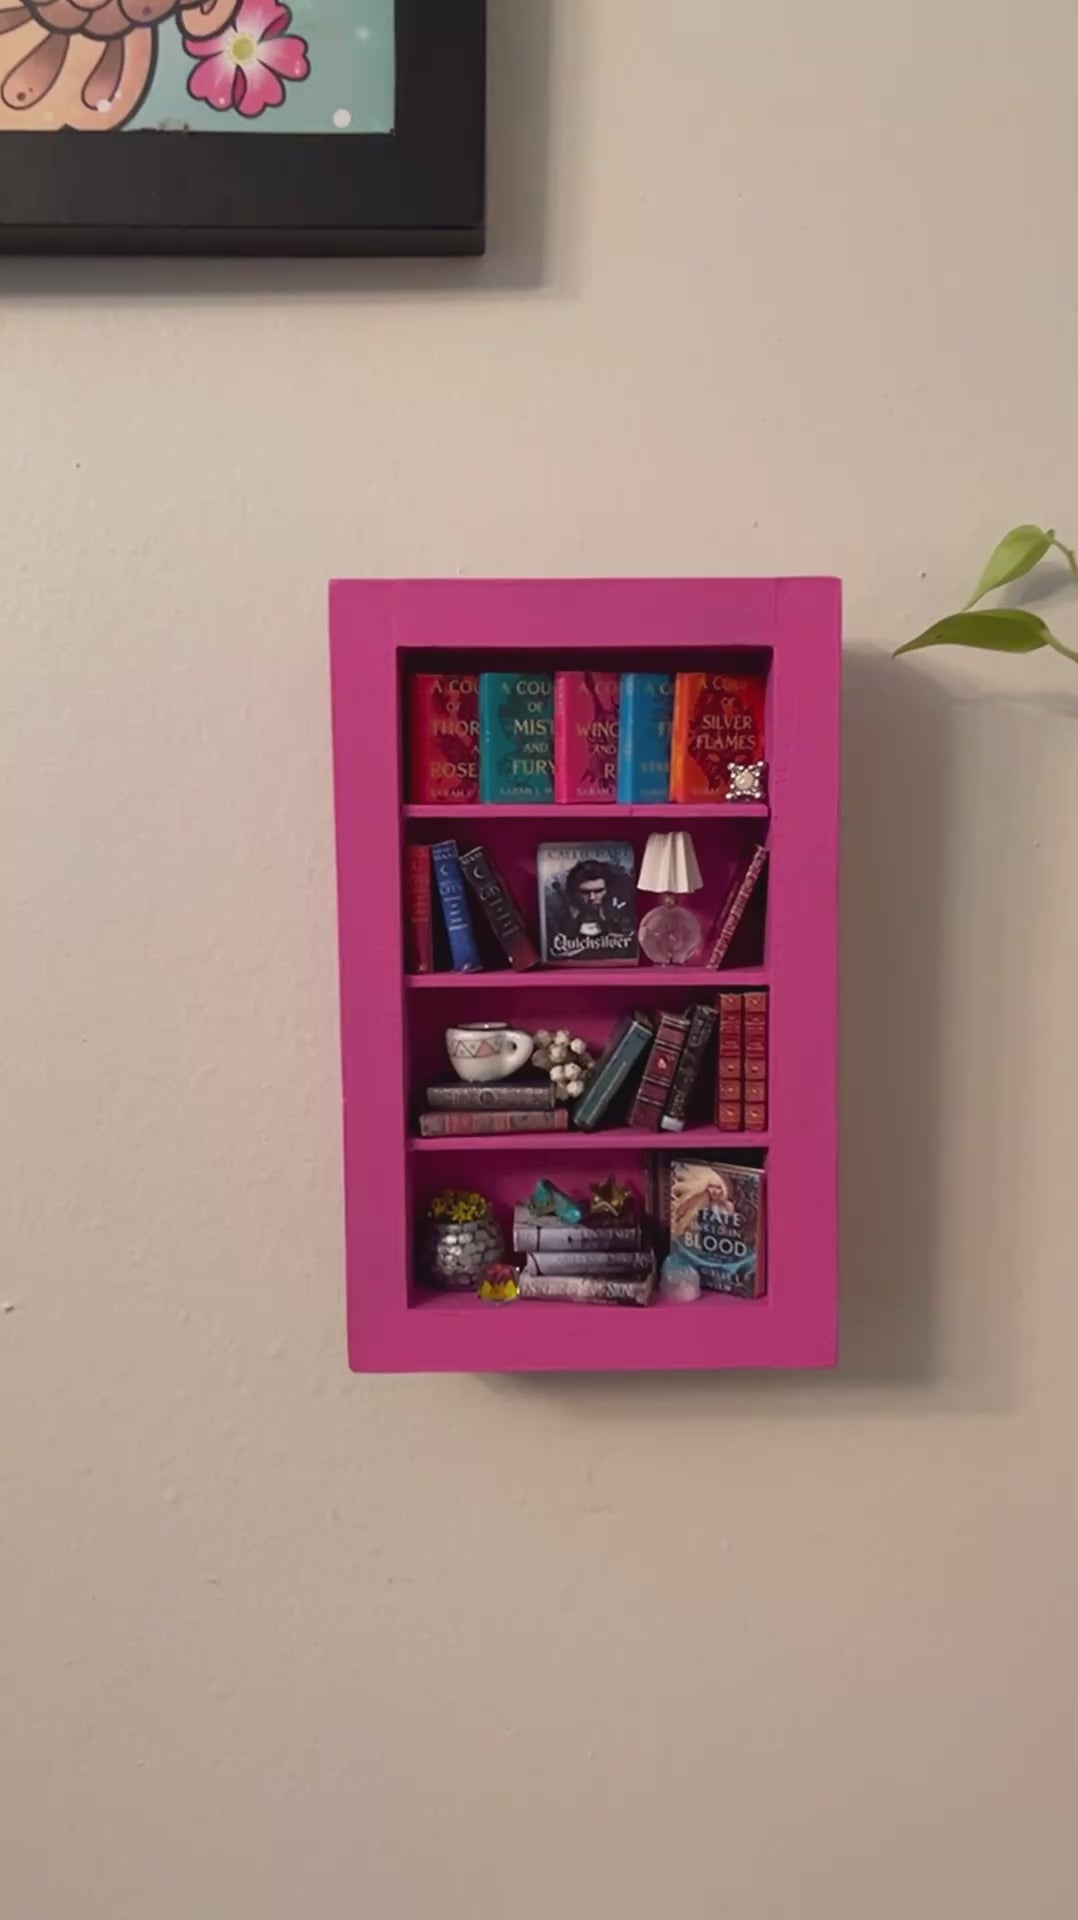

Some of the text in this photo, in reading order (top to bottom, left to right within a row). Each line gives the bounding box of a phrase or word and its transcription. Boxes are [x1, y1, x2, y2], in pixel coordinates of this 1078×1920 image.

[431, 680, 442, 694] A
[702, 714, 753, 730] SILVER
[523, 743, 549, 754] AND
[695, 733, 757, 750] FLAMES
[550, 930, 634, 957] Quicksilver
[702, 1205, 742, 1227] FATE
[684, 1231, 747, 1257] BLOOD
